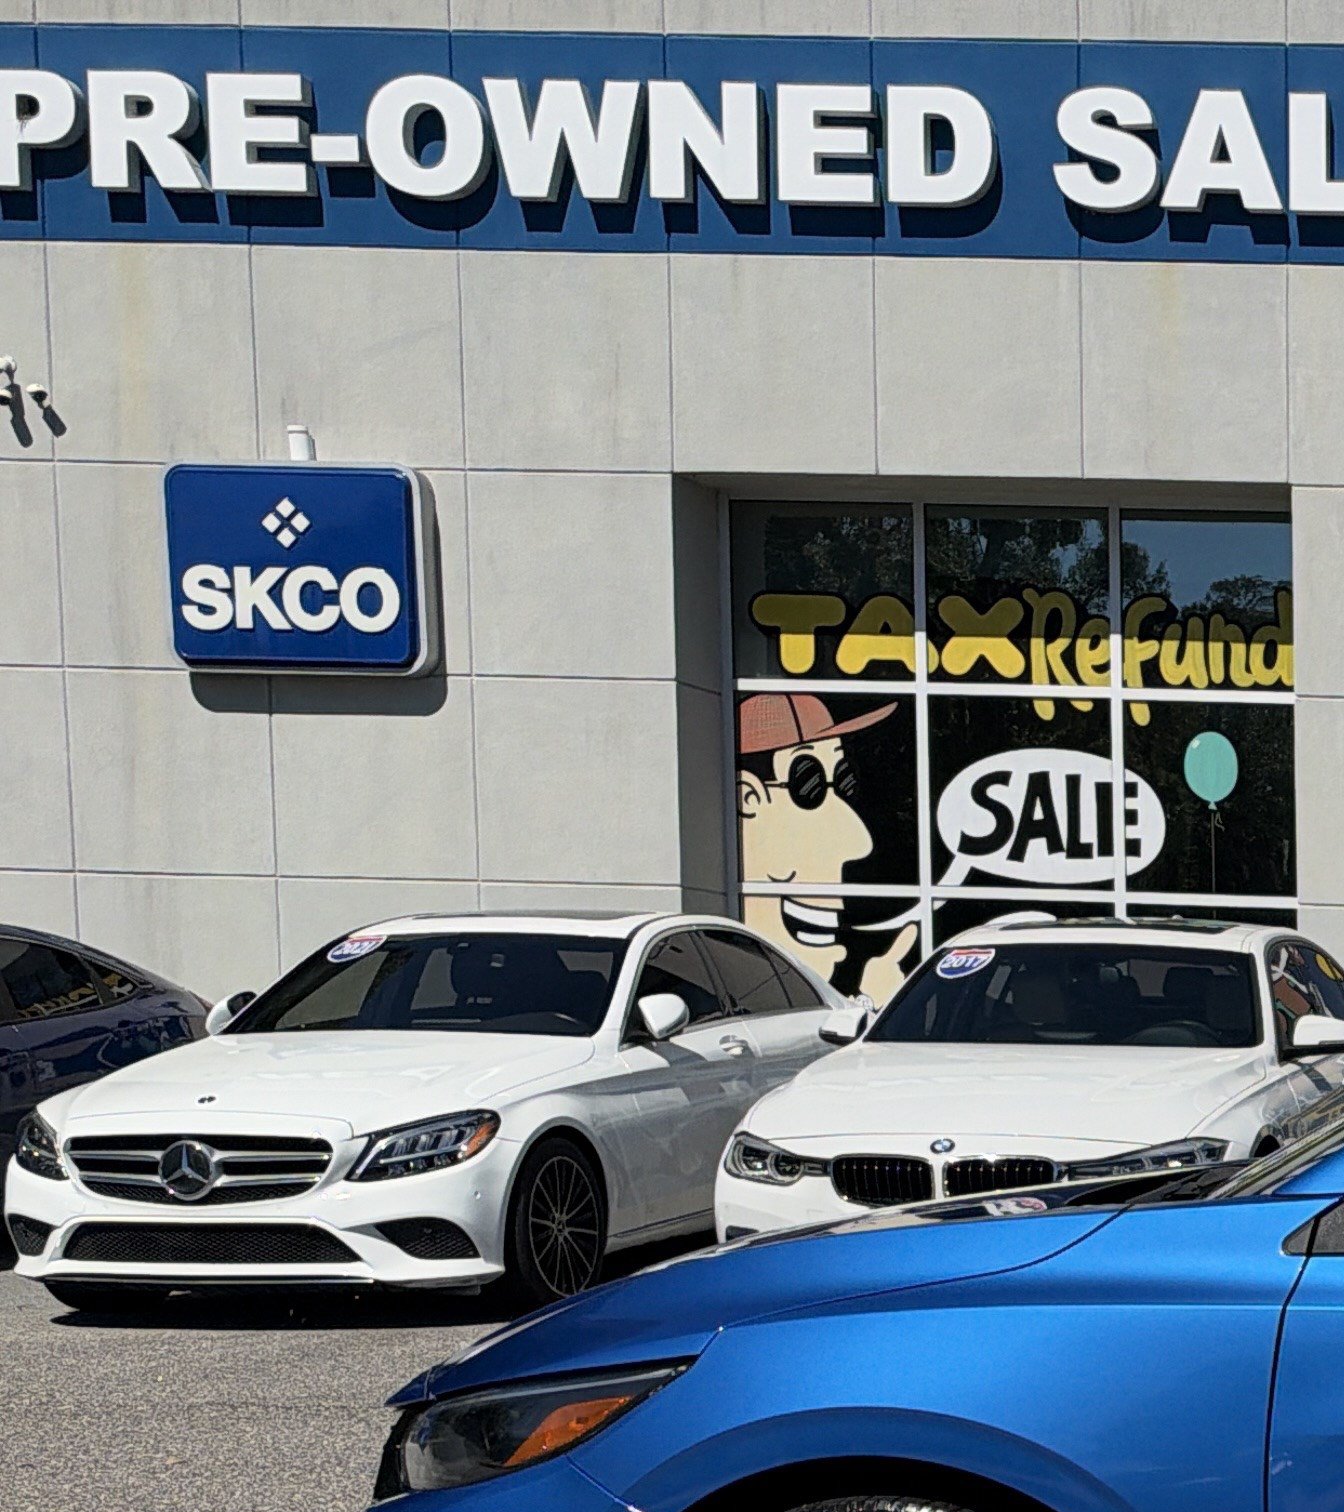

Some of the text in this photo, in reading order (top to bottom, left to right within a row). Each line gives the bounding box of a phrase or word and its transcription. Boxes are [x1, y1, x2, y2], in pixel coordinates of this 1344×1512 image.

[0, 69, 993, 203] PRE-OWNED
[181, 565, 400, 632] SKCO
[752, 588, 1294, 726] TAX Refund
[957, 769, 1142, 863] SALE
[941, 955, 988, 968] 2017
